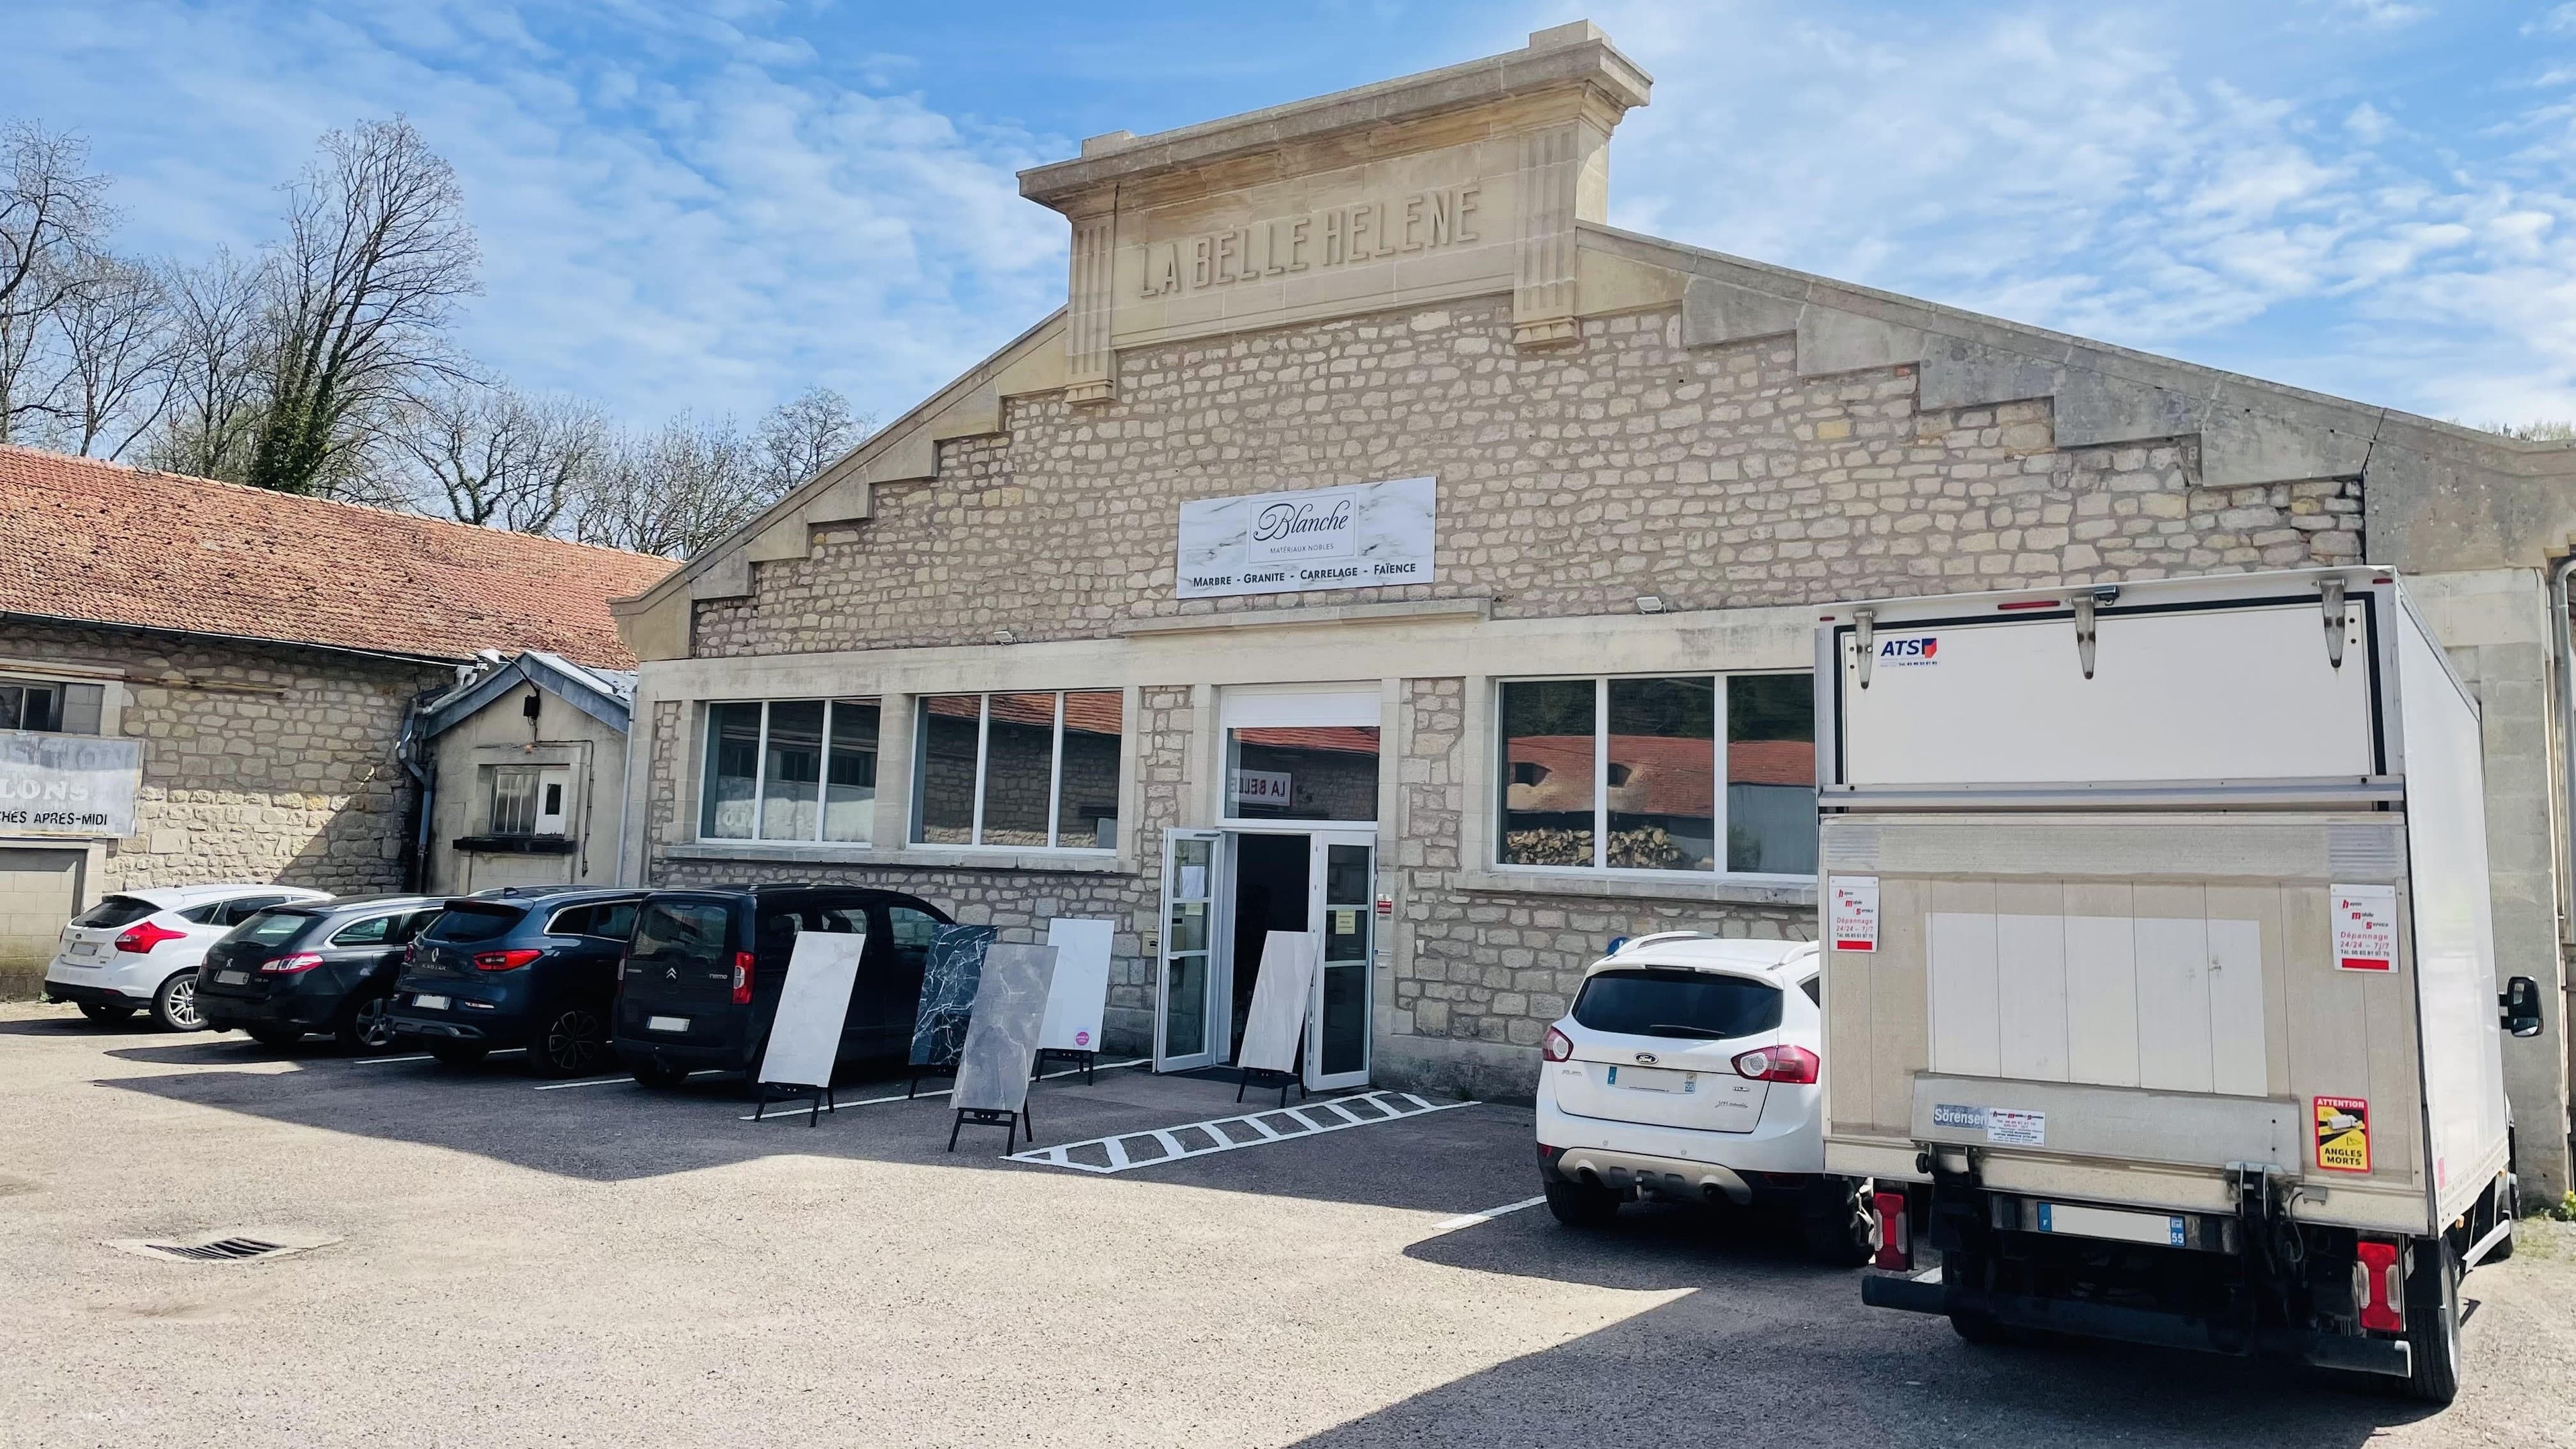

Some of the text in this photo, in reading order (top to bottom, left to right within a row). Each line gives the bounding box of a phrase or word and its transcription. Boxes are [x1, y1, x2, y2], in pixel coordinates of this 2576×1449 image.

[1139, 185, 1482, 298] LA BELLE HELENE
[1253, 500, 1350, 541] Blanche
[1270, 543, 1334, 553] MATÉRIAUX NOBLES
[1880, 639, 1920, 656] ATS
[0, 810, 28, 824] HES
[2317, 1098, 2365, 1108] ATTENTION
[1934, 1108, 1987, 1126] Sörensen
[2325, 1148, 2362, 1157] ANGLES
[2326, 1157, 2361, 1165] MORTS
[2171, 1232, 2184, 1244] 55
